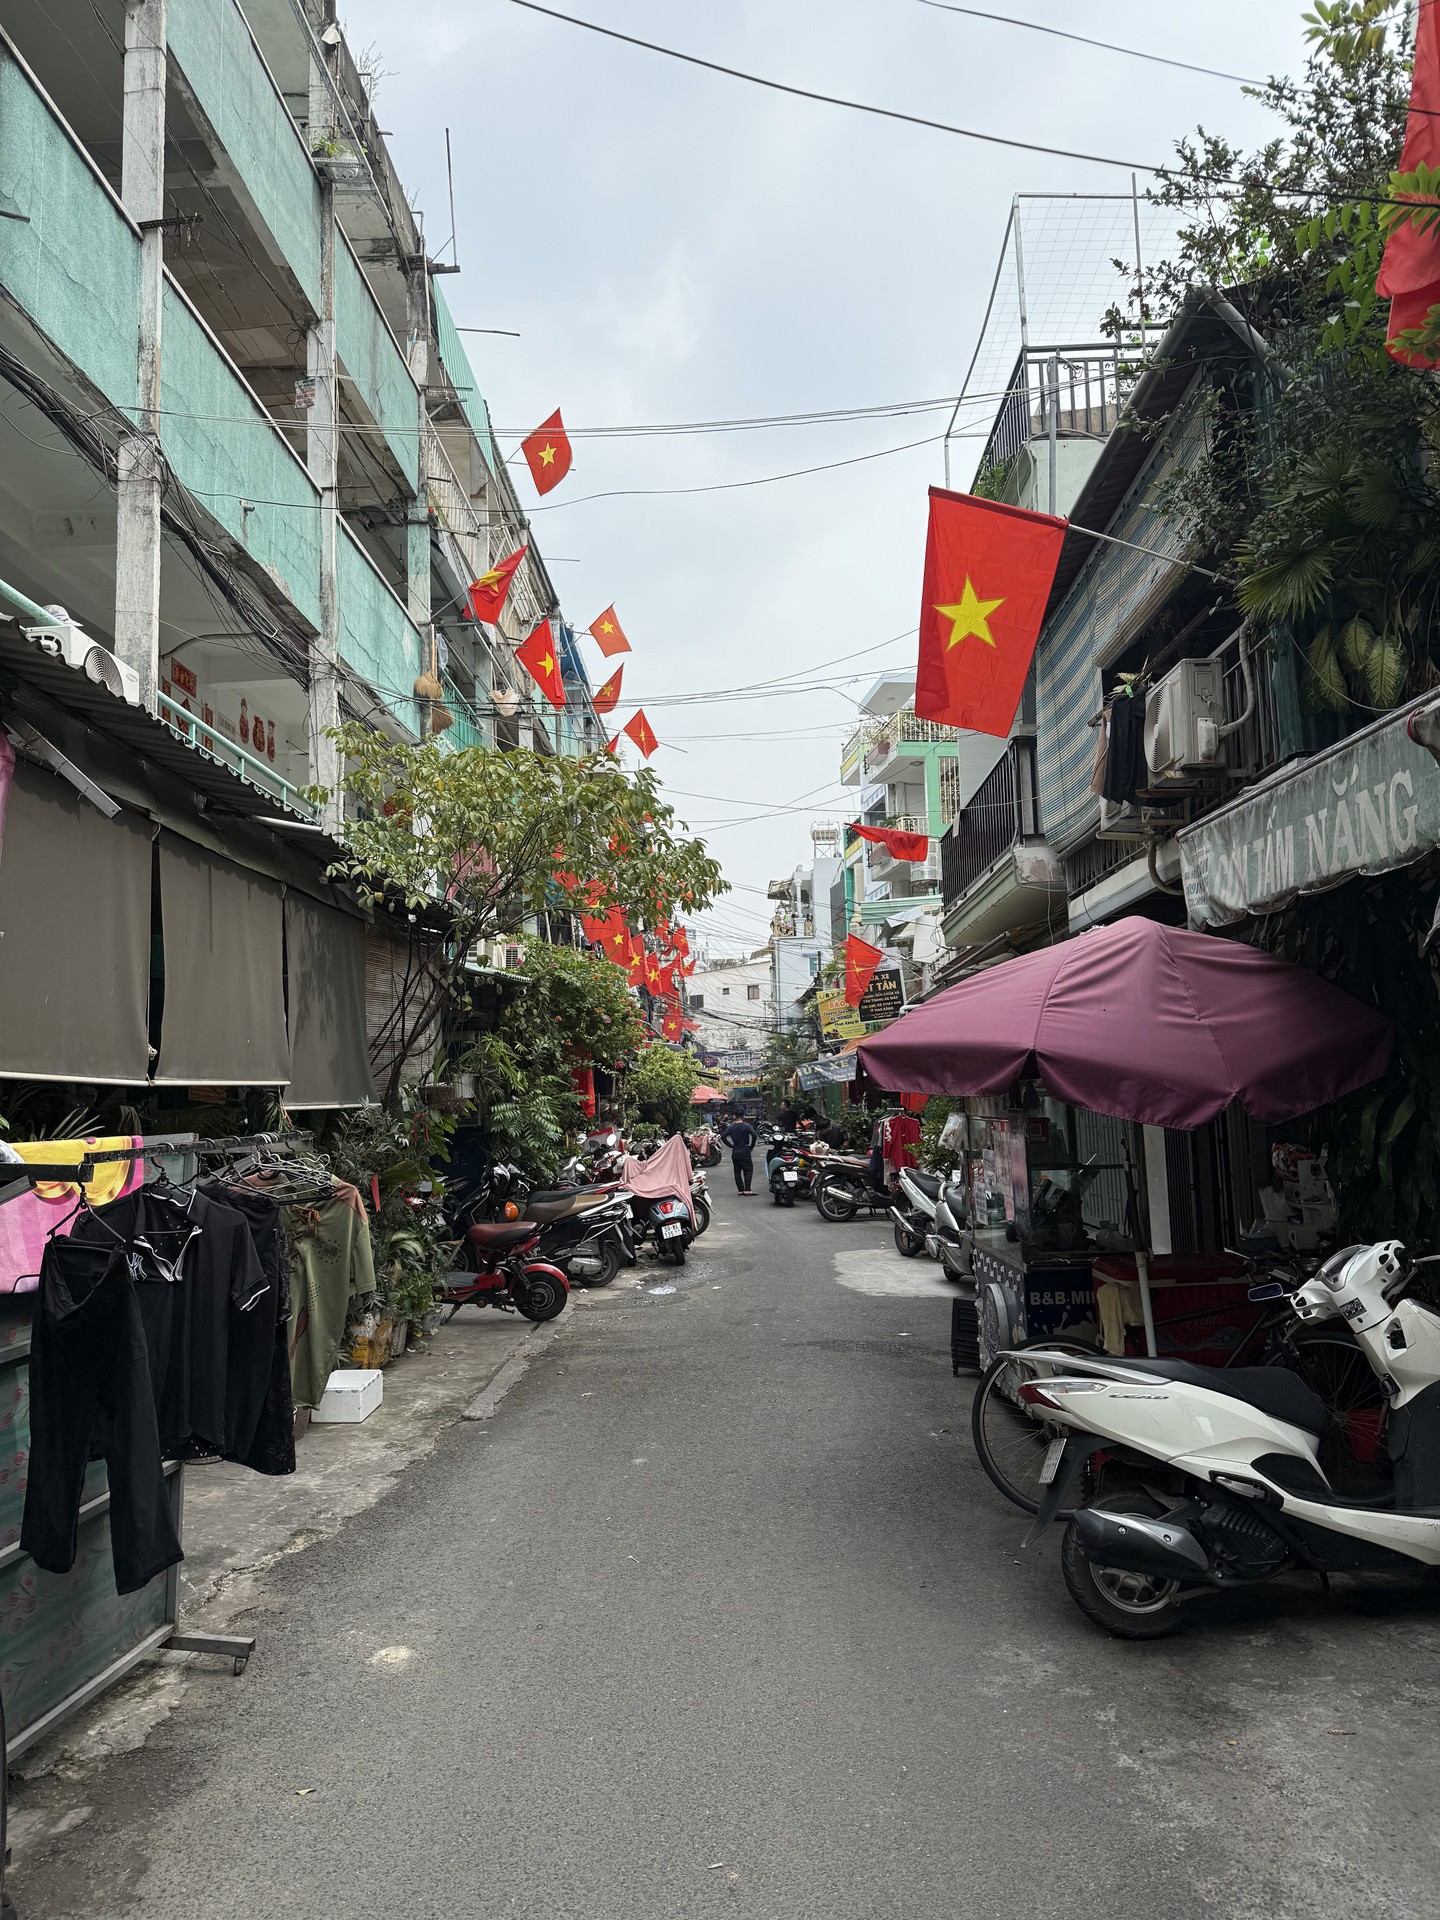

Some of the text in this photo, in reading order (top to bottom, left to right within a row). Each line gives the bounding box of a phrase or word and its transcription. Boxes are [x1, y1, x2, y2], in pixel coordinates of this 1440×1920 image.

[1306, 763, 1418, 878] NẮNG
[829, 1059, 849, 1070] XE
[1030, 1291, 1066, 1306] B&B
